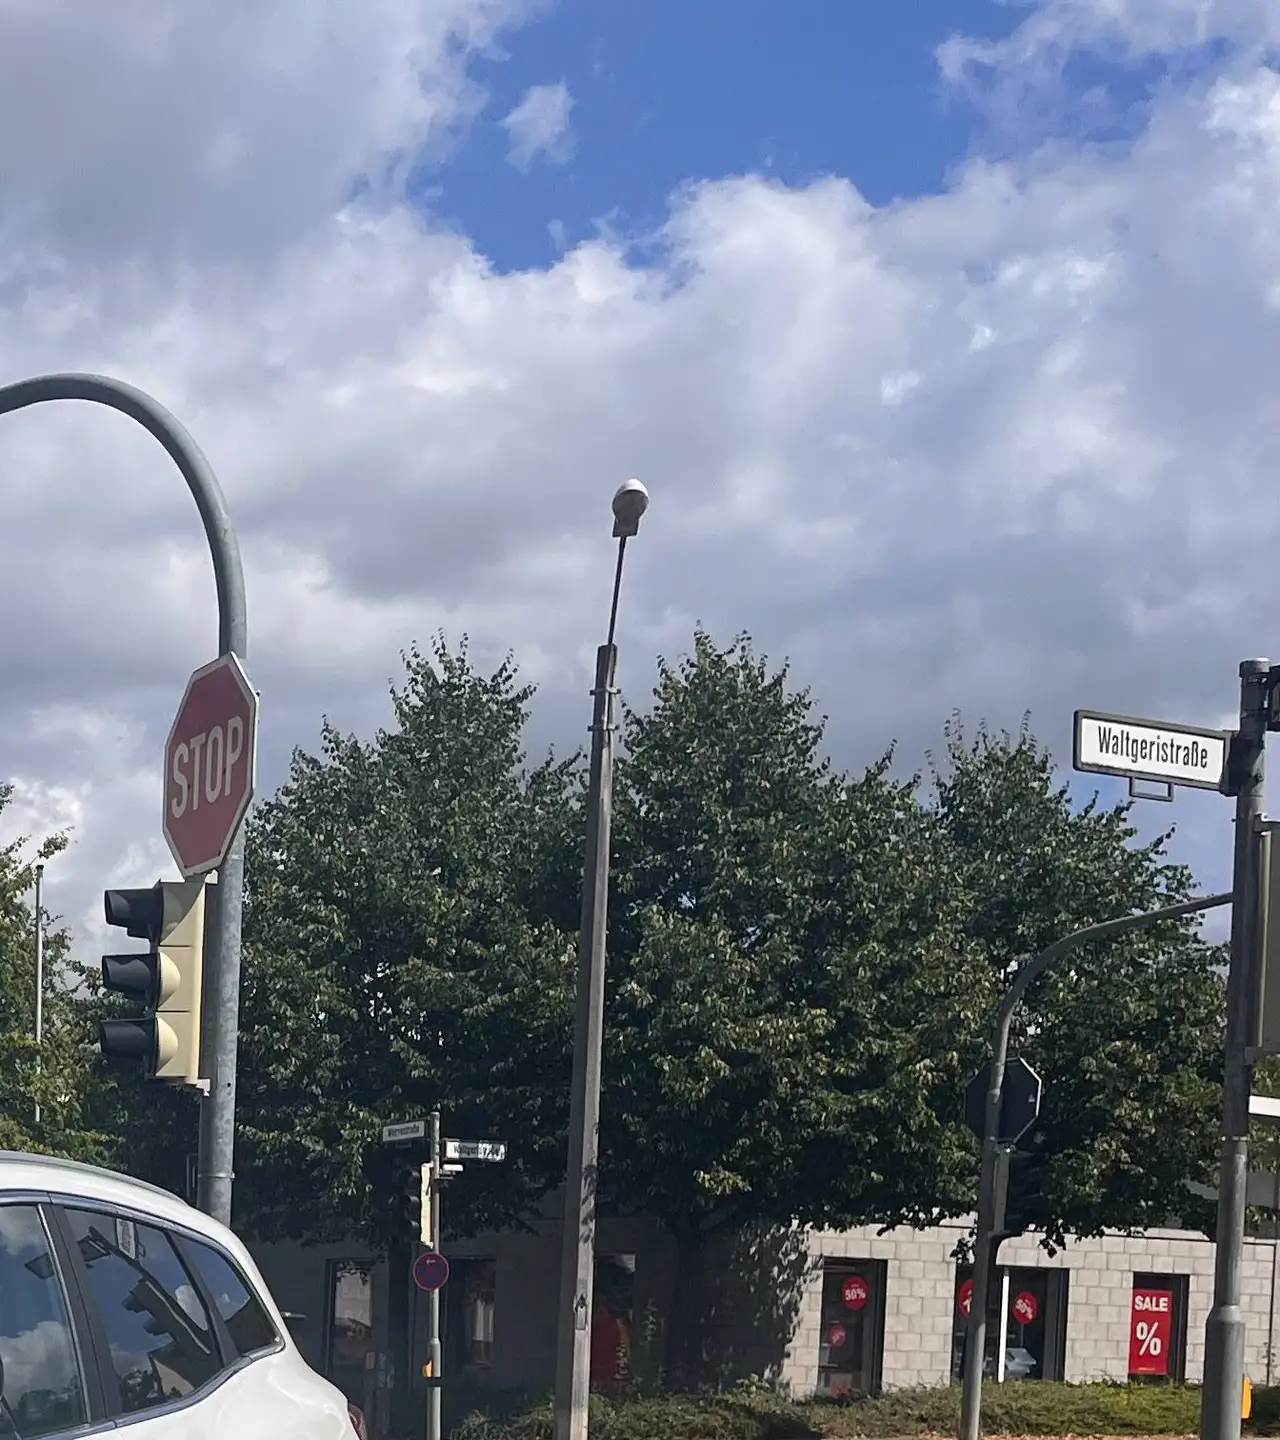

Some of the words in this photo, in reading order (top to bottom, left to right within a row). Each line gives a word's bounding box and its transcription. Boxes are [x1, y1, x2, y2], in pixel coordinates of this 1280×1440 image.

[1097, 724, 1209, 769] Waltgeristraße
[171, 715, 244, 819] STOP
[845, 1288, 866, 1301] 50%
[1134, 1295, 1168, 1312] SALE
[1136, 1321, 1161, 1356] %
